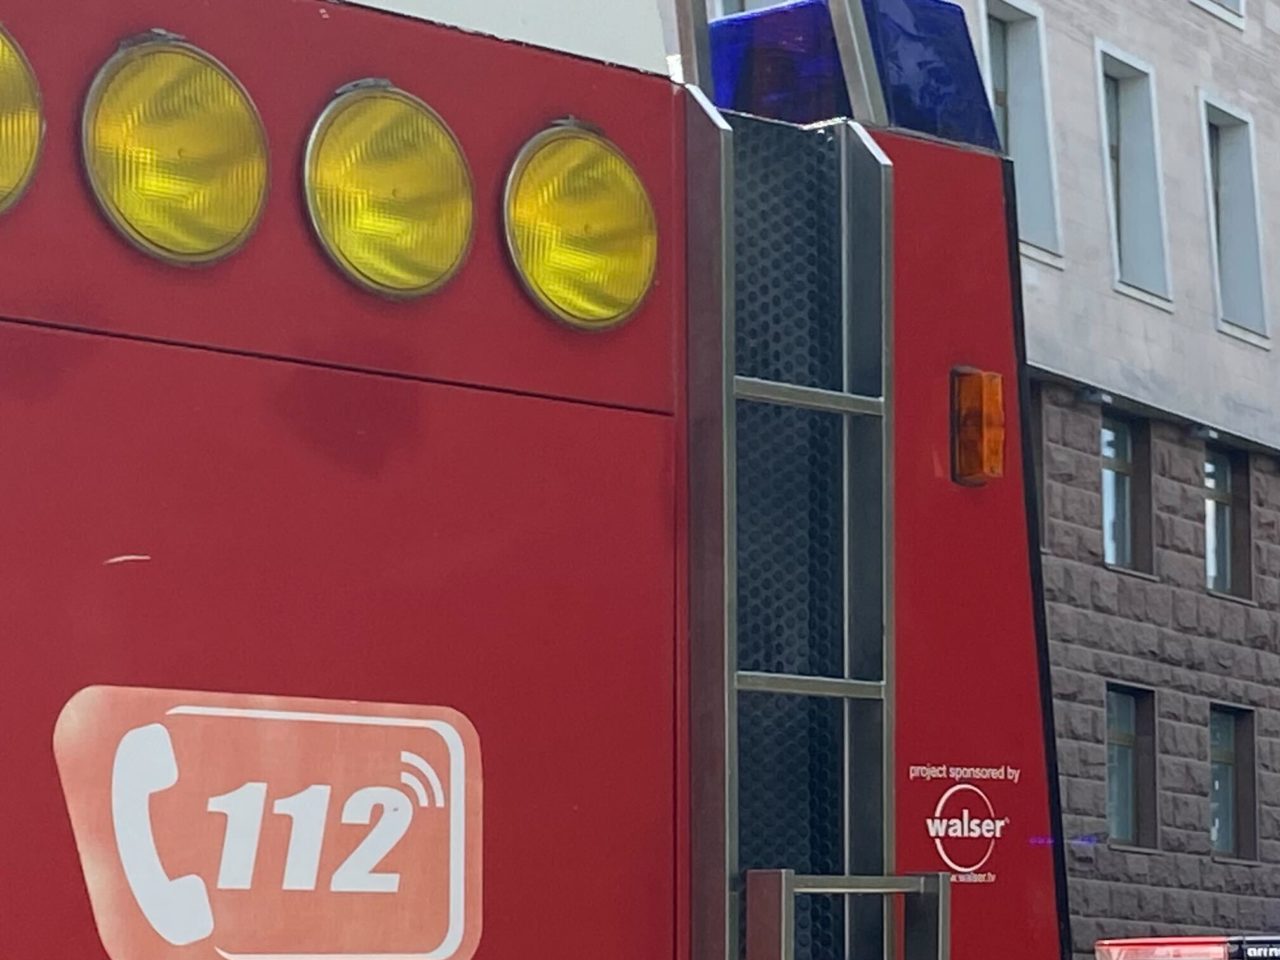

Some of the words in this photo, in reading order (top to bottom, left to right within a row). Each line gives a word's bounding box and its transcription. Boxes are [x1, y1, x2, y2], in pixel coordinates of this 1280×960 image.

[909, 763, 947, 780] project
[949, 765, 1005, 781] sponsored
[1007, 766, 1020, 783] by
[207, 782, 414, 893] 112
[926, 809, 1005, 838] walser
